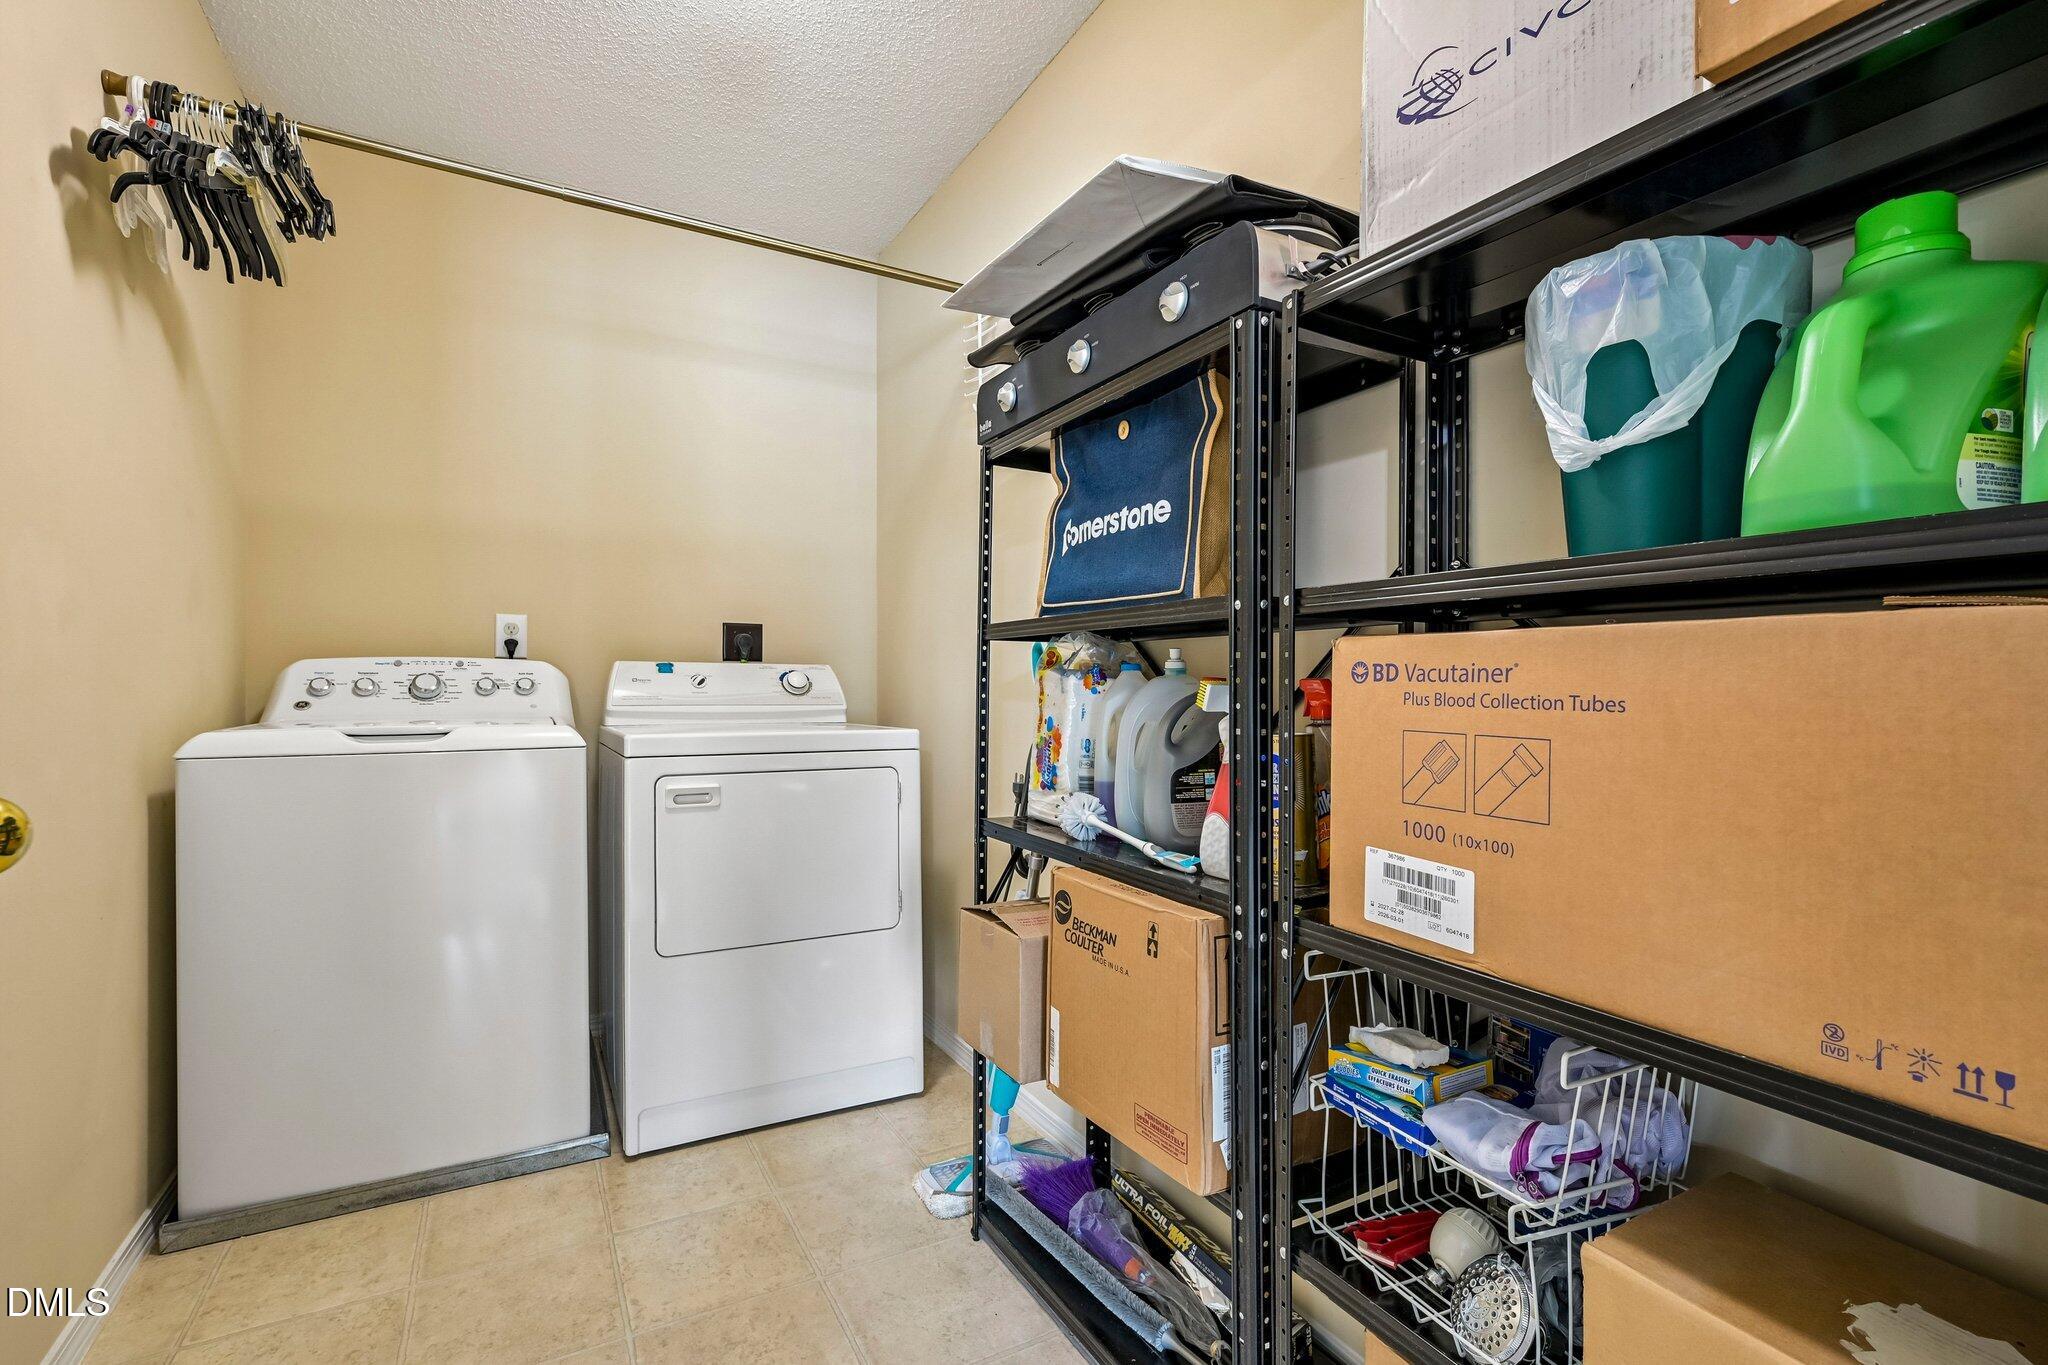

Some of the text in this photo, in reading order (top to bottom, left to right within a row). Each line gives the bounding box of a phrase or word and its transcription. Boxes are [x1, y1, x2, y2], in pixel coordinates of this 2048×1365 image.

[1372, 663, 1399, 682] BD
[1403, 691, 1626, 713] Plus Blood Collection Tubes
[1402, 819, 1515, 858] 1000 (10x100)
[1072, 916, 1117, 947] BECKMAN
[1064, 928, 1104, 957] COULTER
[1092, 954, 1107, 967] MADE
[1825, 1044, 1845, 1058] IVD
[1368, 1074, 1395, 1089] EFFACEURS
[1371, 1067, 1411, 1085] QUICK ERASERS
[1114, 1173, 1168, 1230] ULTRA FOIL
